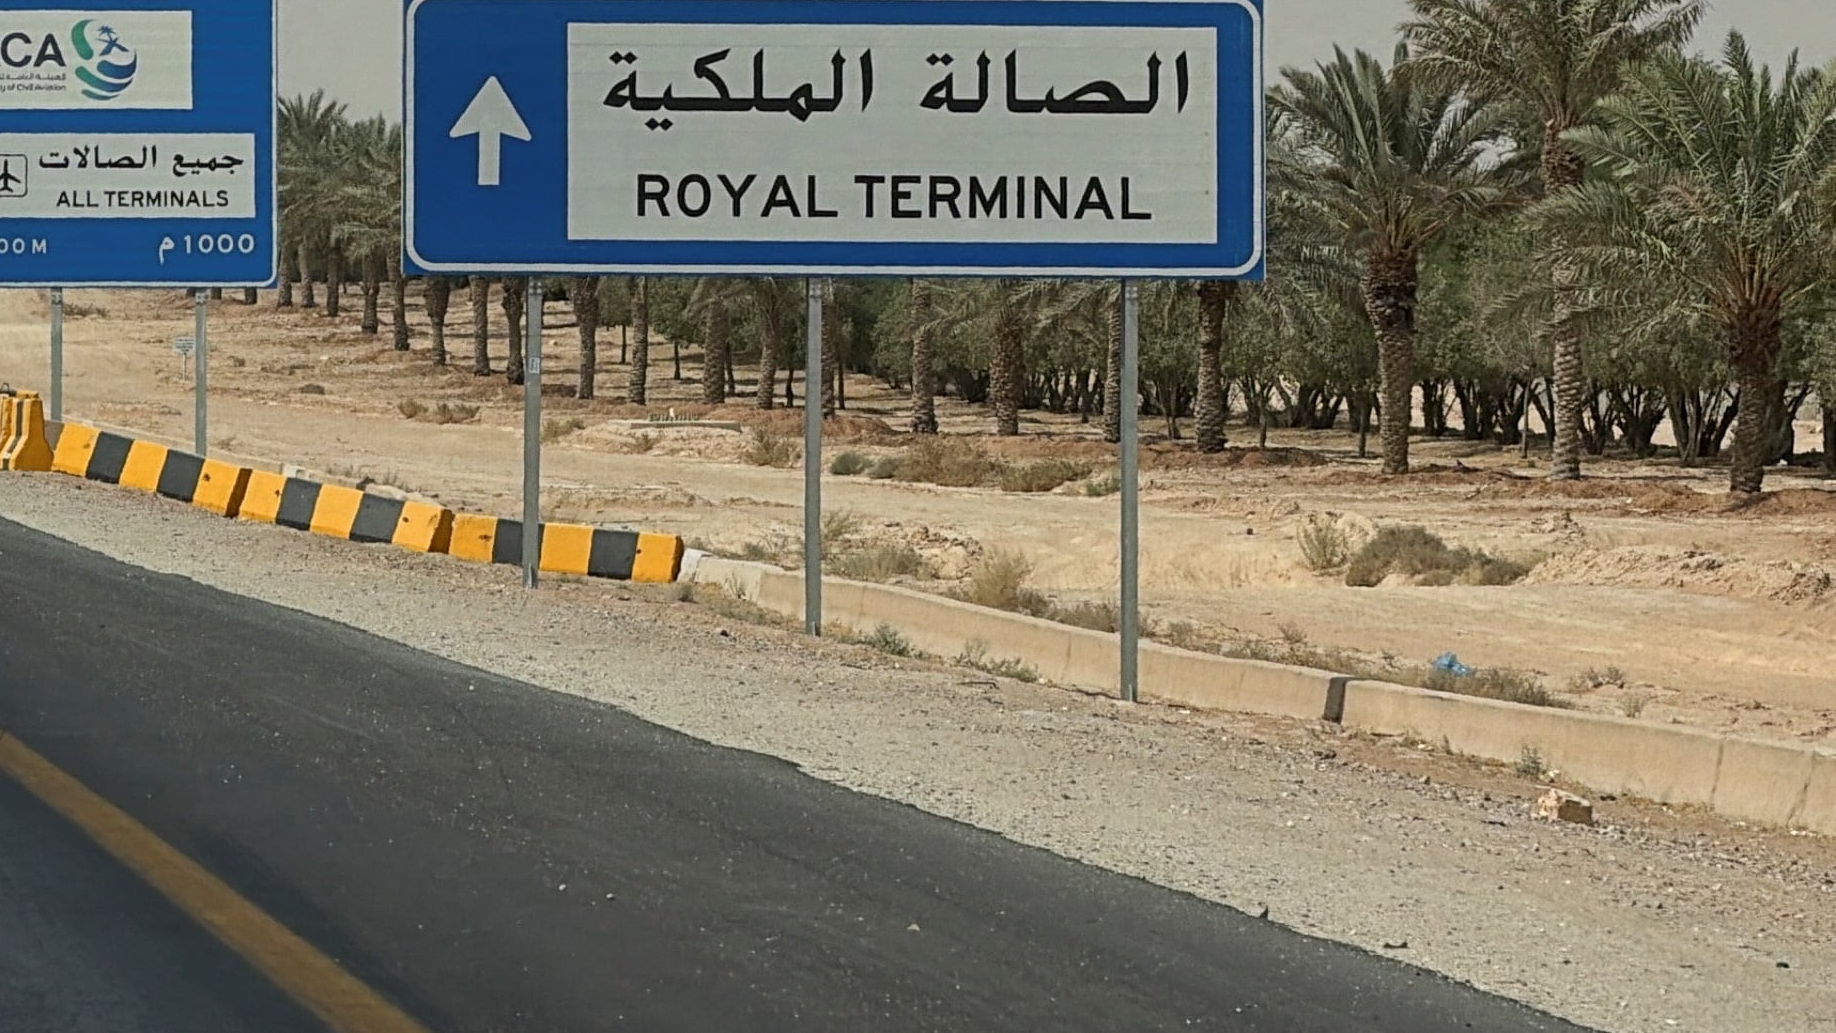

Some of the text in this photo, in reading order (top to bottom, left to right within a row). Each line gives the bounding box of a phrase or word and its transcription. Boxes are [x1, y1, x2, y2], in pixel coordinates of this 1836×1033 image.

[602, 48, 1189, 131] الصالة الملكية
[38, 144, 244, 178] جميع الصالات
[56, 189, 229, 208] ALL TERMINALS
[637, 173, 1152, 220] ROYAL TERMINAL
[31, 238, 47, 254] M
[158, 233, 255, 264] 1000 م
